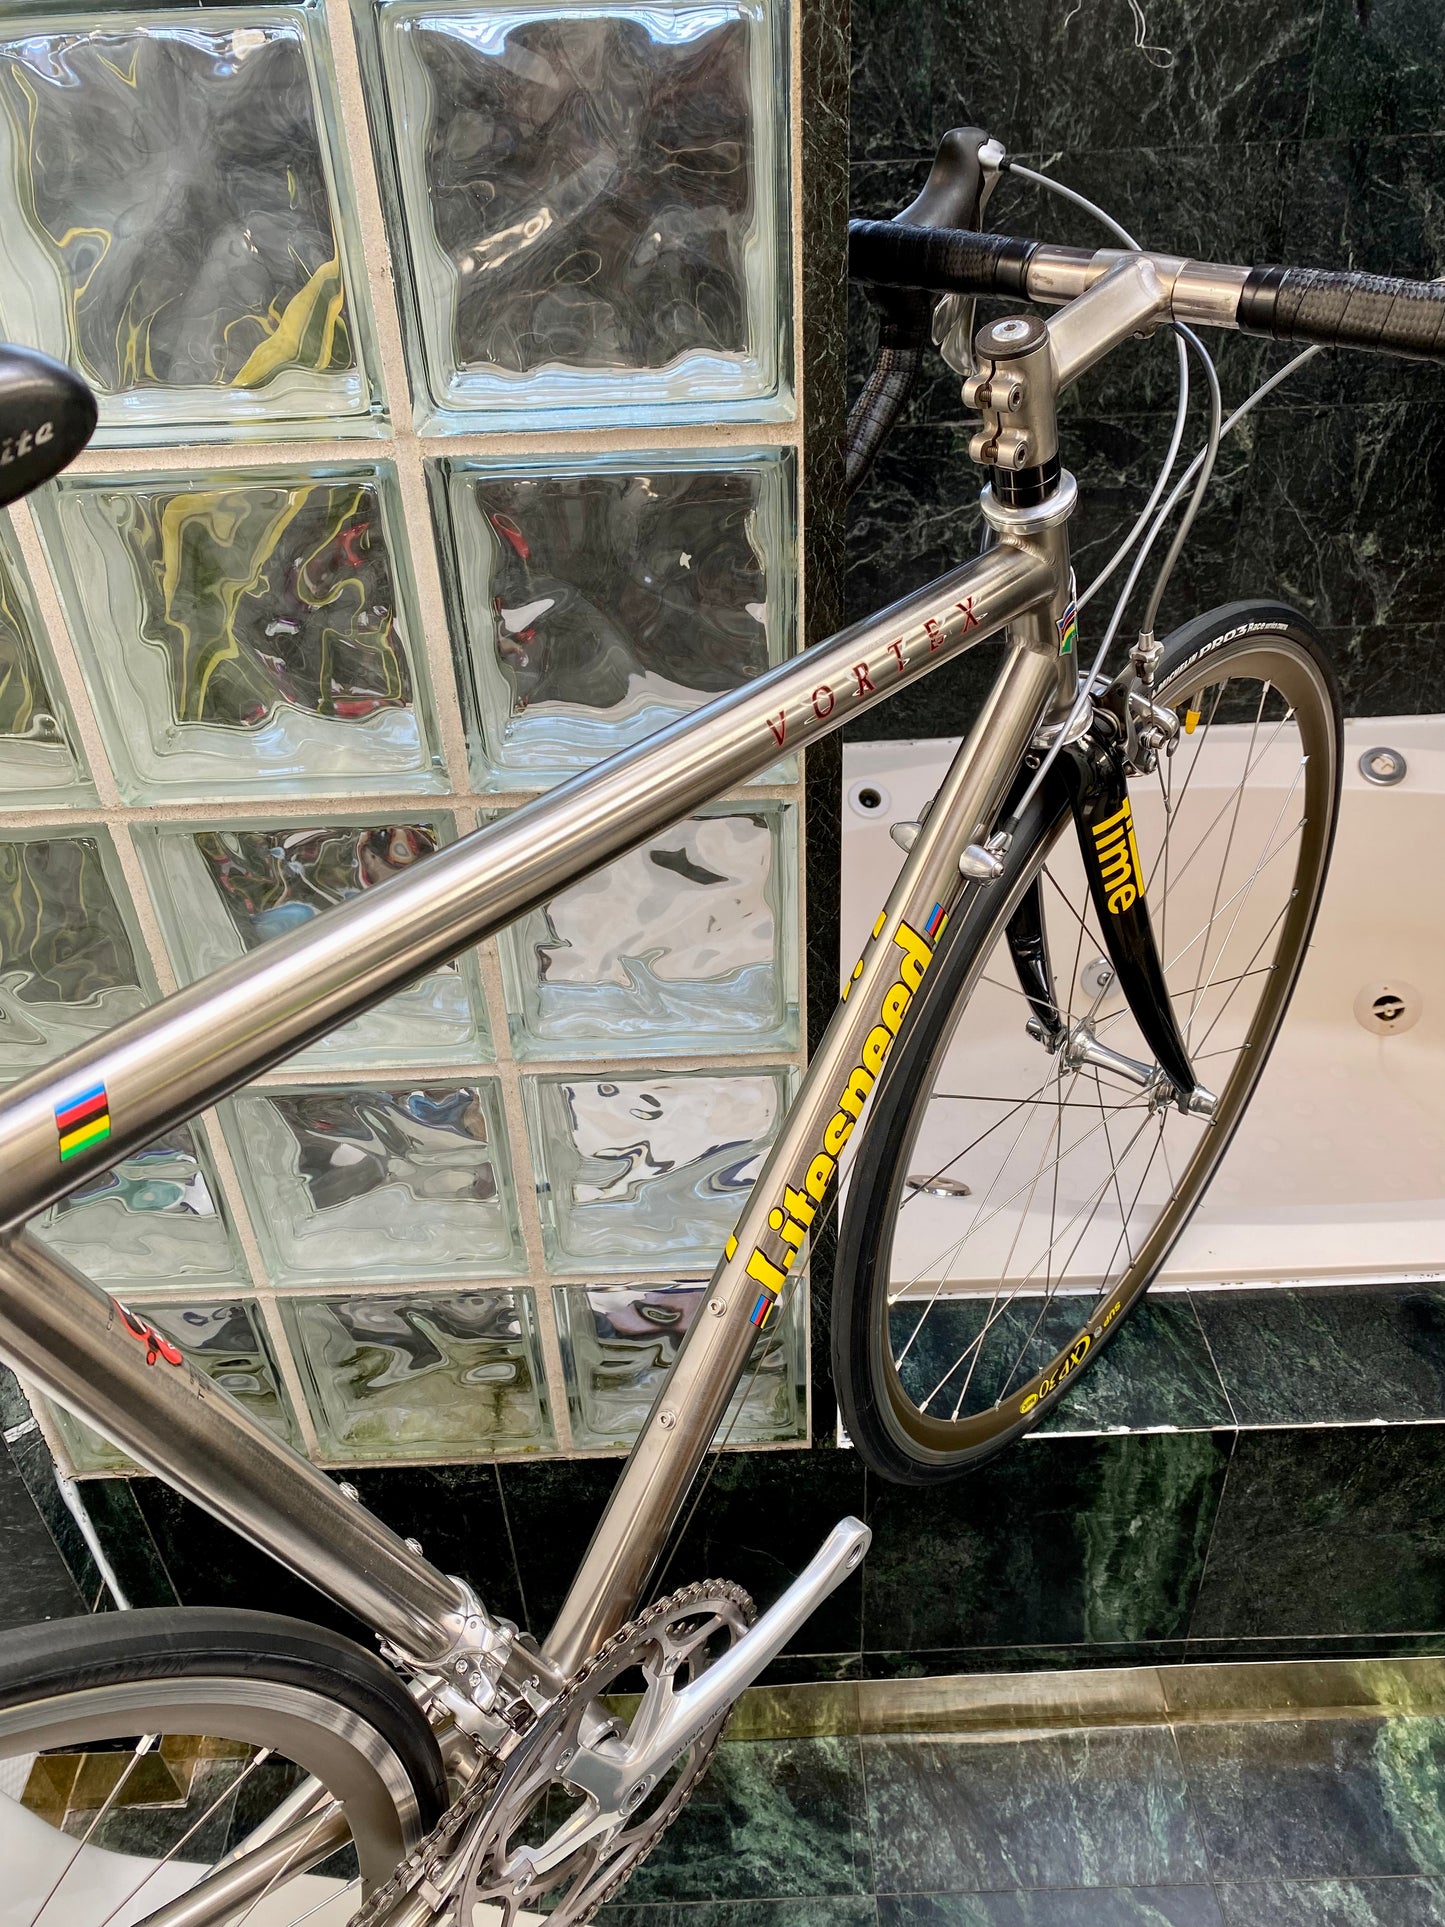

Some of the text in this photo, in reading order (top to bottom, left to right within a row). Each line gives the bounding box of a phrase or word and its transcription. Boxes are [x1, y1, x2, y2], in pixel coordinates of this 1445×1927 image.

[766, 596, 984, 747] VORTEX
[1157, 651, 1199, 693] MICHELIN
[1198, 623, 1250, 659] PRO3
[1091, 796, 1145, 914] Time
[746, 919, 935, 1294] Litespeed
[1103, 1301, 1121, 1327] SUP
[671, 1697, 731, 1761] DURA-ACE
